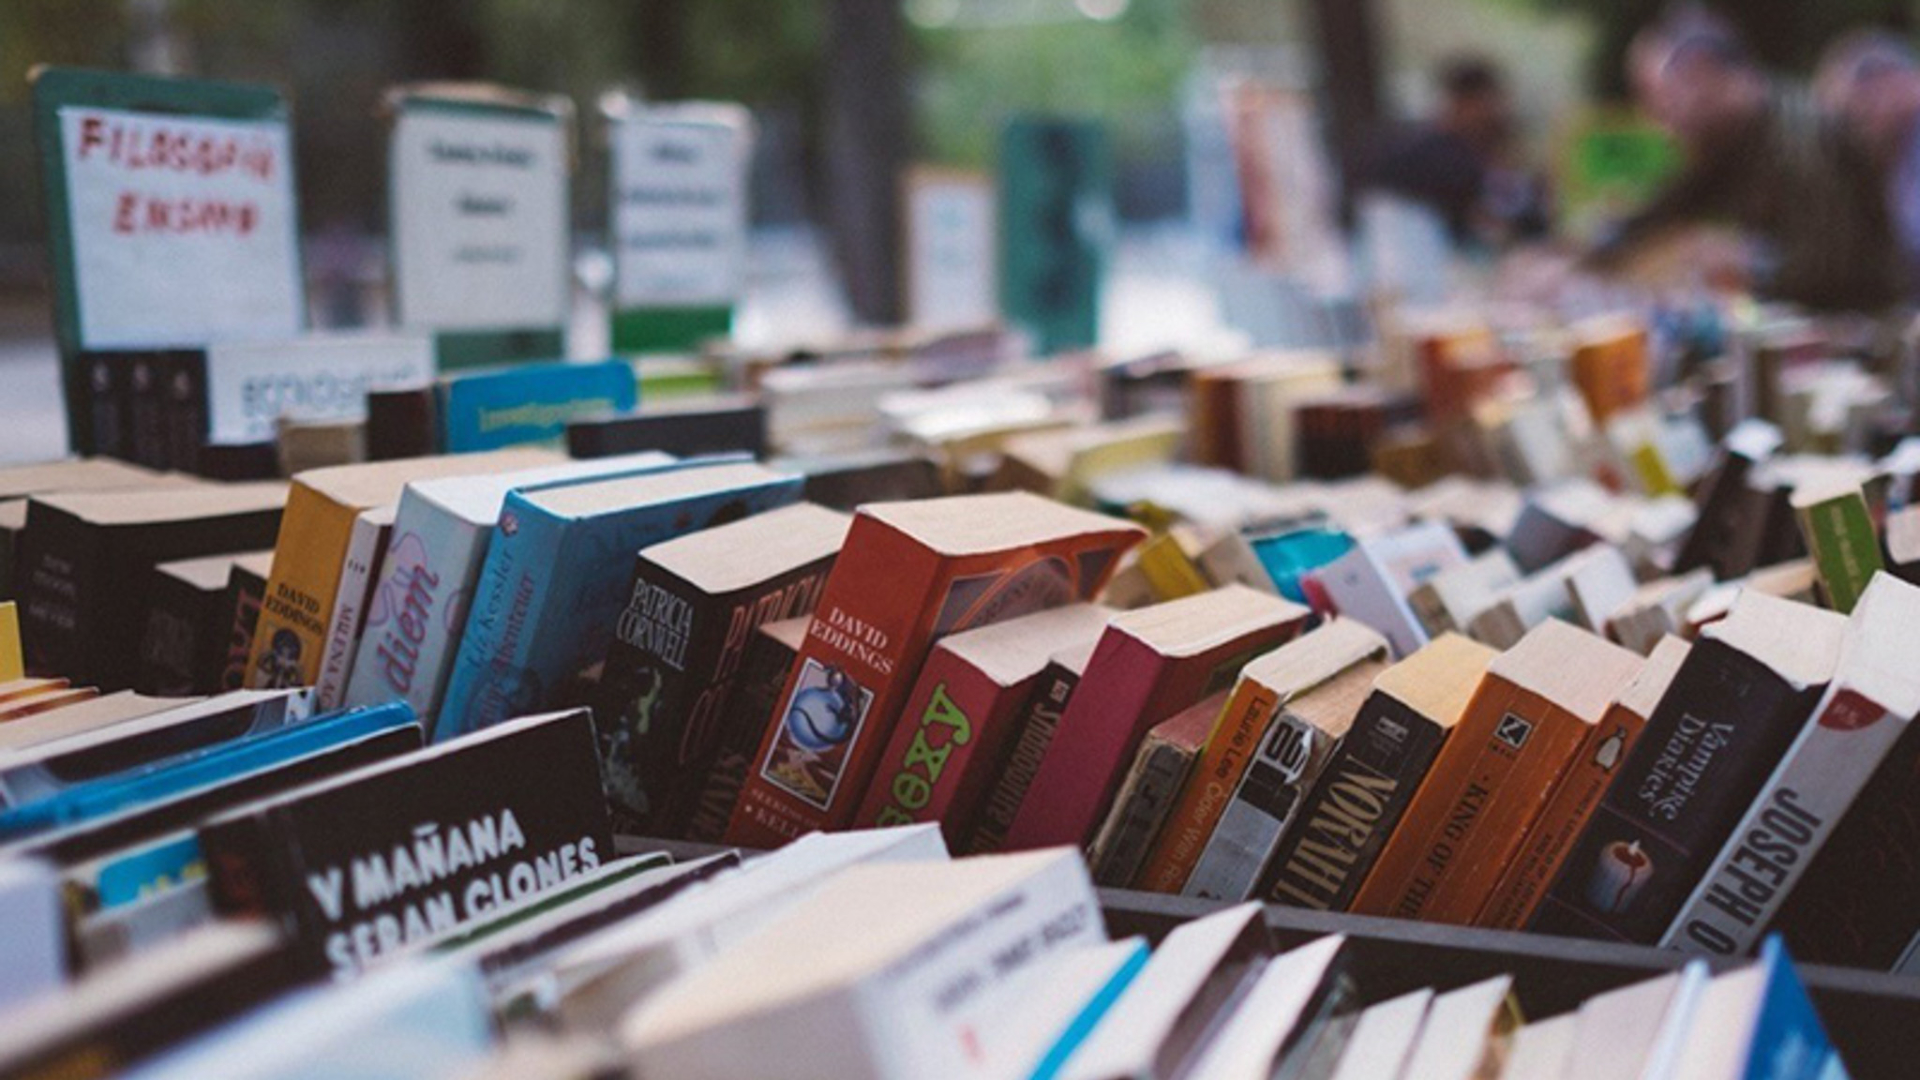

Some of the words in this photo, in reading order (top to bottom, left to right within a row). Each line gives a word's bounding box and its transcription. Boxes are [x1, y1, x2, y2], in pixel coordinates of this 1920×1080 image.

[265, 597, 323, 634] EDDINGS
[276, 582, 321, 614] DAVID
[630, 577, 693, 638] PATRICIA
[377, 564, 439, 694] diem
[616, 607, 686, 671] CORNWELL
[808, 618, 893, 674] EDDINGS
[828, 606, 888, 649] DAVID
[1232, 696, 1270, 748] Laurie
[1215, 746, 1243, 779] Lee
[1194, 782, 1225, 826] Cider
[1286, 753, 1398, 893] NORAH
[1445, 781, 1489, 843] KING
[307, 867, 343, 922] Y
[351, 808, 525, 909] MAÑANA
[465, 836, 600, 917] CLONES
[1428, 842, 1452, 876] OF
[1703, 787, 1823, 926] JOSEPH
